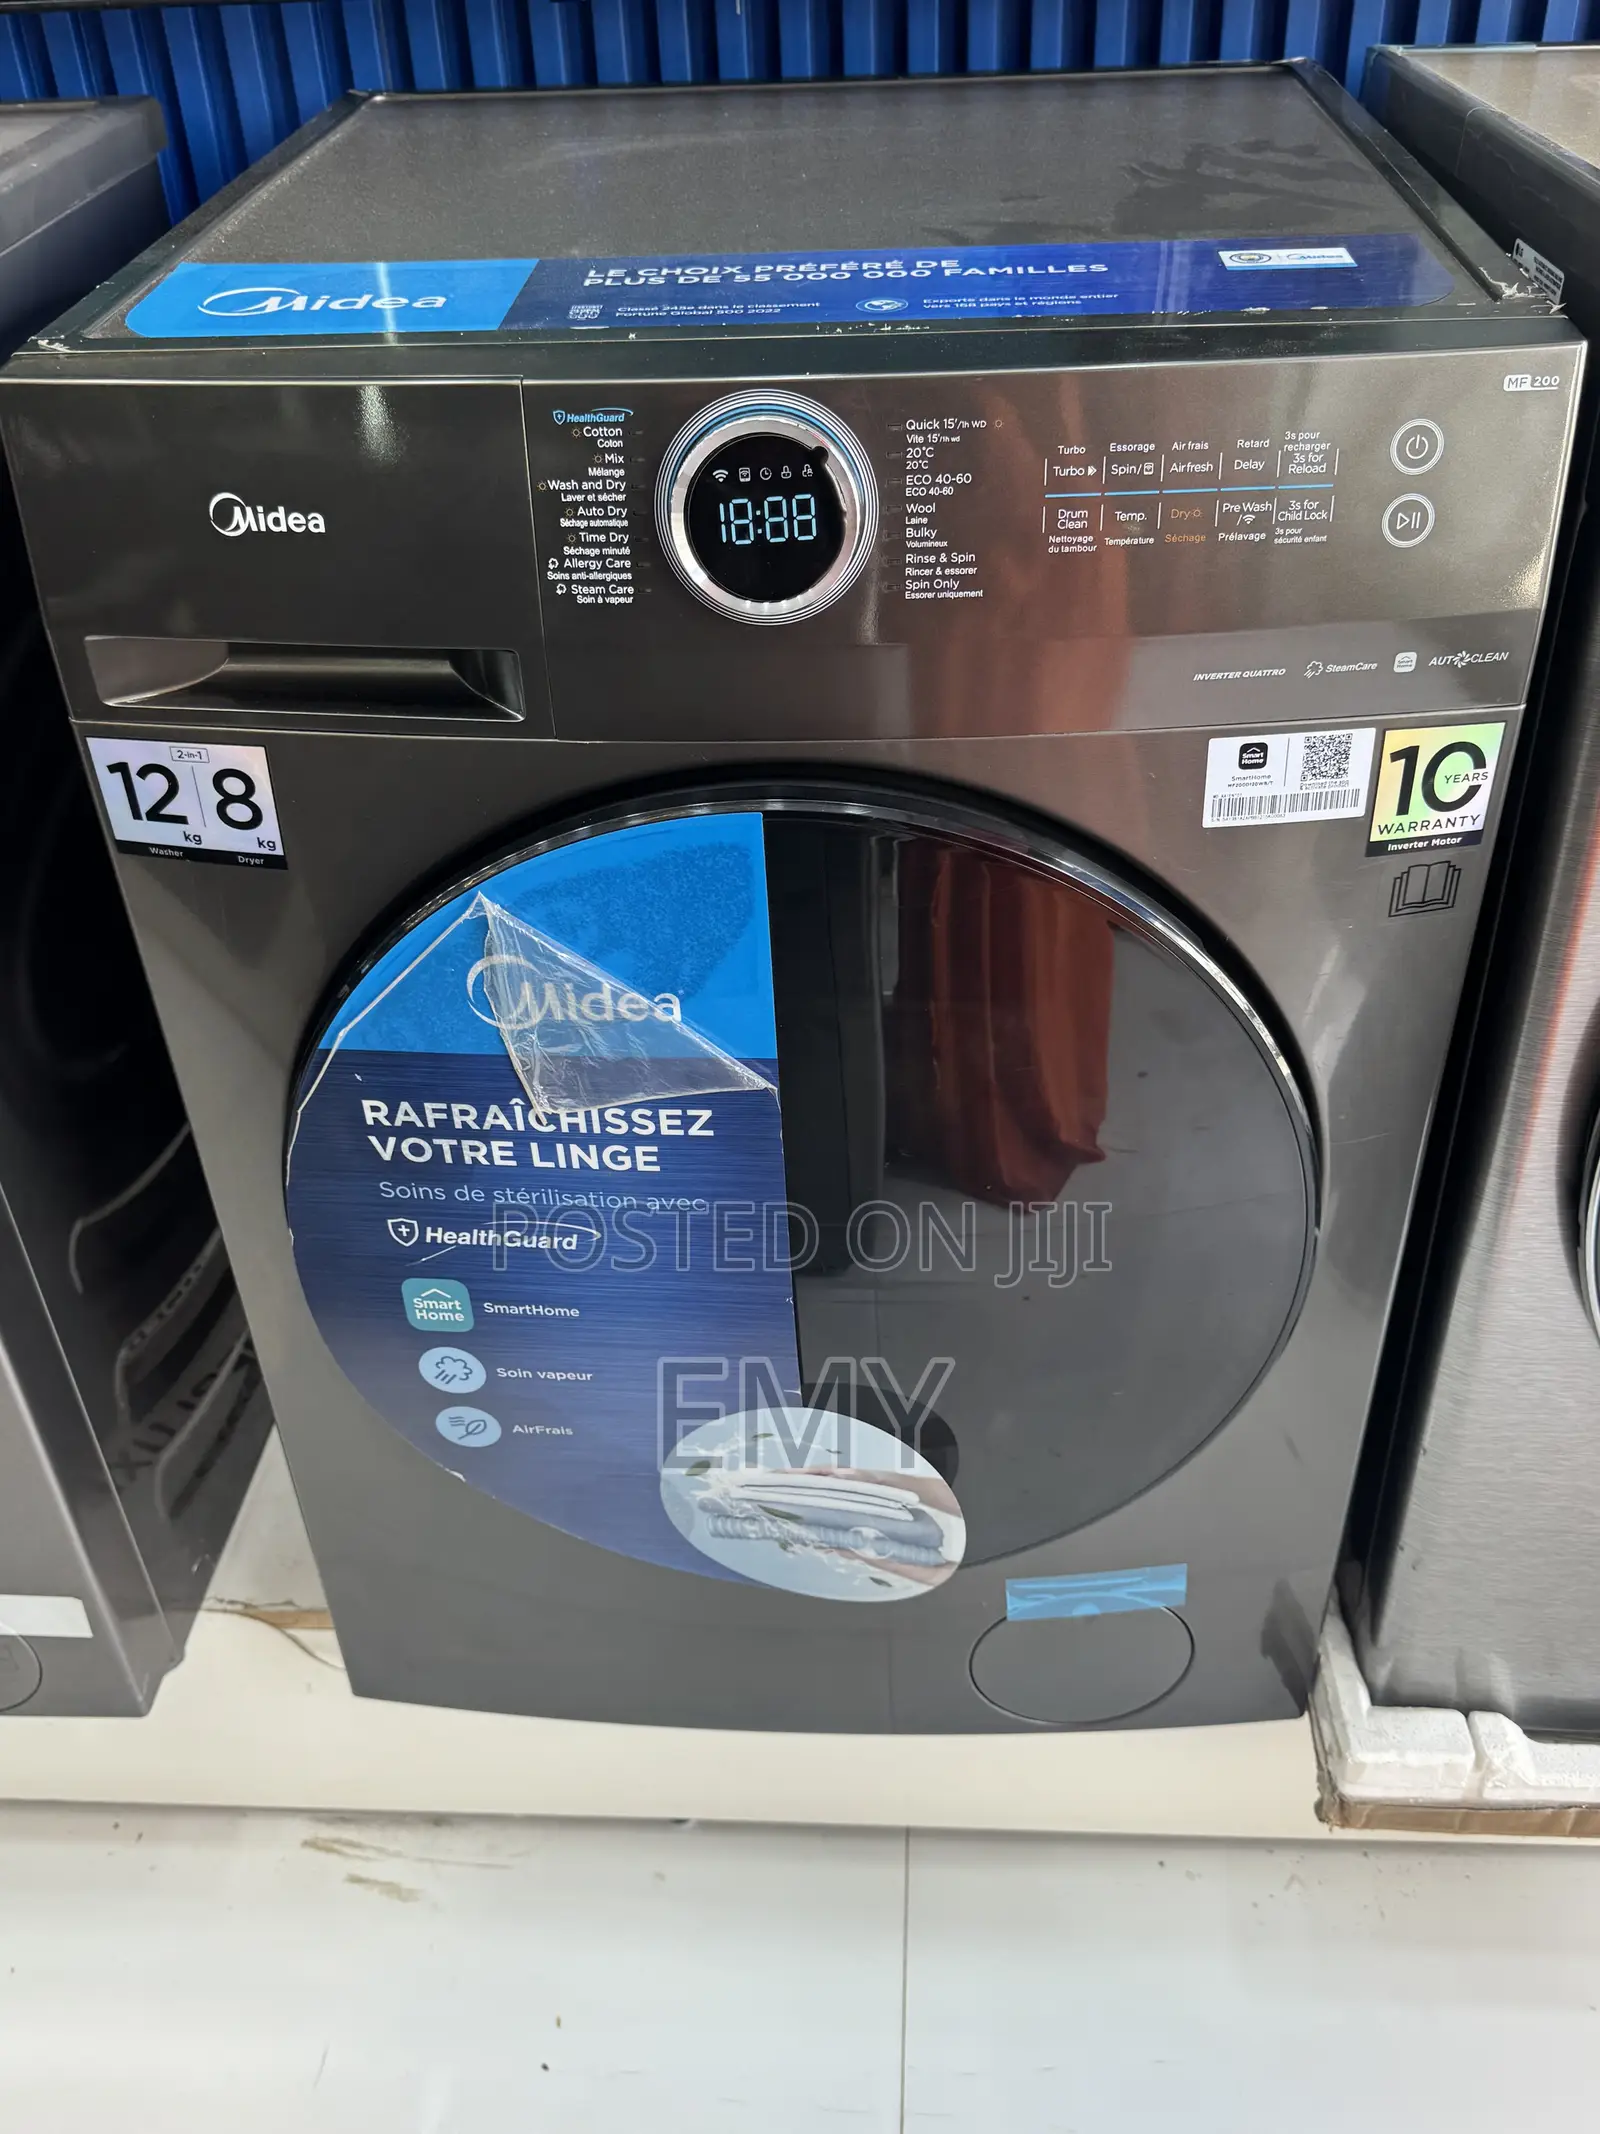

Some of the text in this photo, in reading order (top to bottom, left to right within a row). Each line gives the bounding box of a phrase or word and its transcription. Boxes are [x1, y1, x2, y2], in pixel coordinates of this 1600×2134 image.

[587, 259, 960, 278] LE CHOIX PRÉFÉRÉ DE
[583, 264, 1109, 287] PLUS DE 55 000 000 FAMILLES
[197, 287, 447, 316] Midea
[748, 302, 820, 310] classement
[1508, 375, 1560, 388] MF 200
[566, 412, 626, 424] HealthGuard
[906, 419, 987, 431] Quick WD
[582, 426, 623, 437] Cotton
[1285, 431, 1320, 441] 3s pour
[906, 434, 924, 444] Vite
[1237, 439, 1270, 448] Retard
[1057, 445, 1086, 454] Turbo
[1109, 443, 1156, 453] Essorage
[1171, 441, 1209, 451] Air frais
[1284, 442, 1331, 452] recharger
[906, 447, 934, 458] 20°C
[1293, 452, 1324, 463] 3s for
[604, 453, 625, 464] Mix
[906, 460, 929, 469] 20°C
[1234, 459, 1265, 471] Delay
[1288, 463, 1326, 474] Reload
[587, 467, 625, 479] Mélange
[1053, 466, 1085, 476] Turbo
[906, 473, 972, 485] ECO 40-60
[547, 479, 626, 492] Wash and Dry
[561, 492, 627, 502] Laver et sécher
[906, 487, 954, 496] ECO 40-60
[906, 503, 936, 513] Wool
[1222, 501, 1272, 513] Pre Wash
[1289, 500, 1319, 510] 3s for
[209, 492, 325, 536] Midea
[577, 506, 628, 518] Auto Dry
[1058, 509, 1088, 519] Drum
[1115, 511, 1147, 522] Temp.
[1171, 509, 1191, 520] Dry
[1278, 510, 1328, 521] Child Lock
[559, 518, 629, 529] Séchage automatique
[719, 493, 817, 545] 18:88
[906, 516, 928, 524] Laine
[1057, 519, 1088, 529] Clean
[579, 532, 629, 544] Time Dry
[906, 528, 937, 539] Bulky
[1165, 533, 1206, 543] Séchage
[1218, 531, 1266, 542] Prélavage
[906, 540, 948, 548] Volumineux
[1048, 535, 1093, 544] Nettoyage
[1104, 537, 1154, 546] Température
[1274, 535, 1327, 544] sécurité enfant
[563, 545, 631, 557] Séchage minuté
[1048, 544, 1098, 553] du tambour
[563, 557, 632, 570] Allergy Care
[906, 552, 976, 565] Rinse & Spin
[547, 571, 633, 582] Soins anti-allergiques
[905, 567, 977, 576] Rincer & essorer
[571, 584, 635, 595] Steam Care
[905, 579, 960, 591] Spin Only
[576, 595, 634, 605] Soin à vapeur
[905, 589, 983, 600] Essorer uniquement
[1325, 662, 1378, 673] SteamCare
[1193, 668, 1286, 681] INVERTER QUATTRO
[177, 750, 203, 759] 2-in-1
[1231, 774, 1271, 782] SmartHome
[1390, 741, 1486, 816] 10
[1444, 771, 1489, 784] YEARS
[106, 762, 189, 825] 12
[212, 768, 263, 830] 8
[1378, 814, 1481, 836] WARRANTY
[183, 831, 202, 845] kg
[1388, 835, 1463, 851] Inverter Motor
[257, 837, 276, 851] kg
[149, 847, 183, 858] Washer
[237, 856, 265, 866] Dryer
[466, 955, 683, 1030] Midea
[361, 1098, 715, 1137] RAFRAÎCHISSEZ
[367, 1136, 661, 1173] VOTRE LINGE
[379, 1181, 706, 1212] Soins de stérilisation avec
[425, 1226, 578, 1251] HealthGuard
[413, 1298, 462, 1311] Smart
[483, 1302, 580, 1318] SmartHome
[415, 1309, 464, 1322] Home
[496, 1367, 593, 1383] Soin vapeur
[512, 1424, 574, 1436] AirFrais
